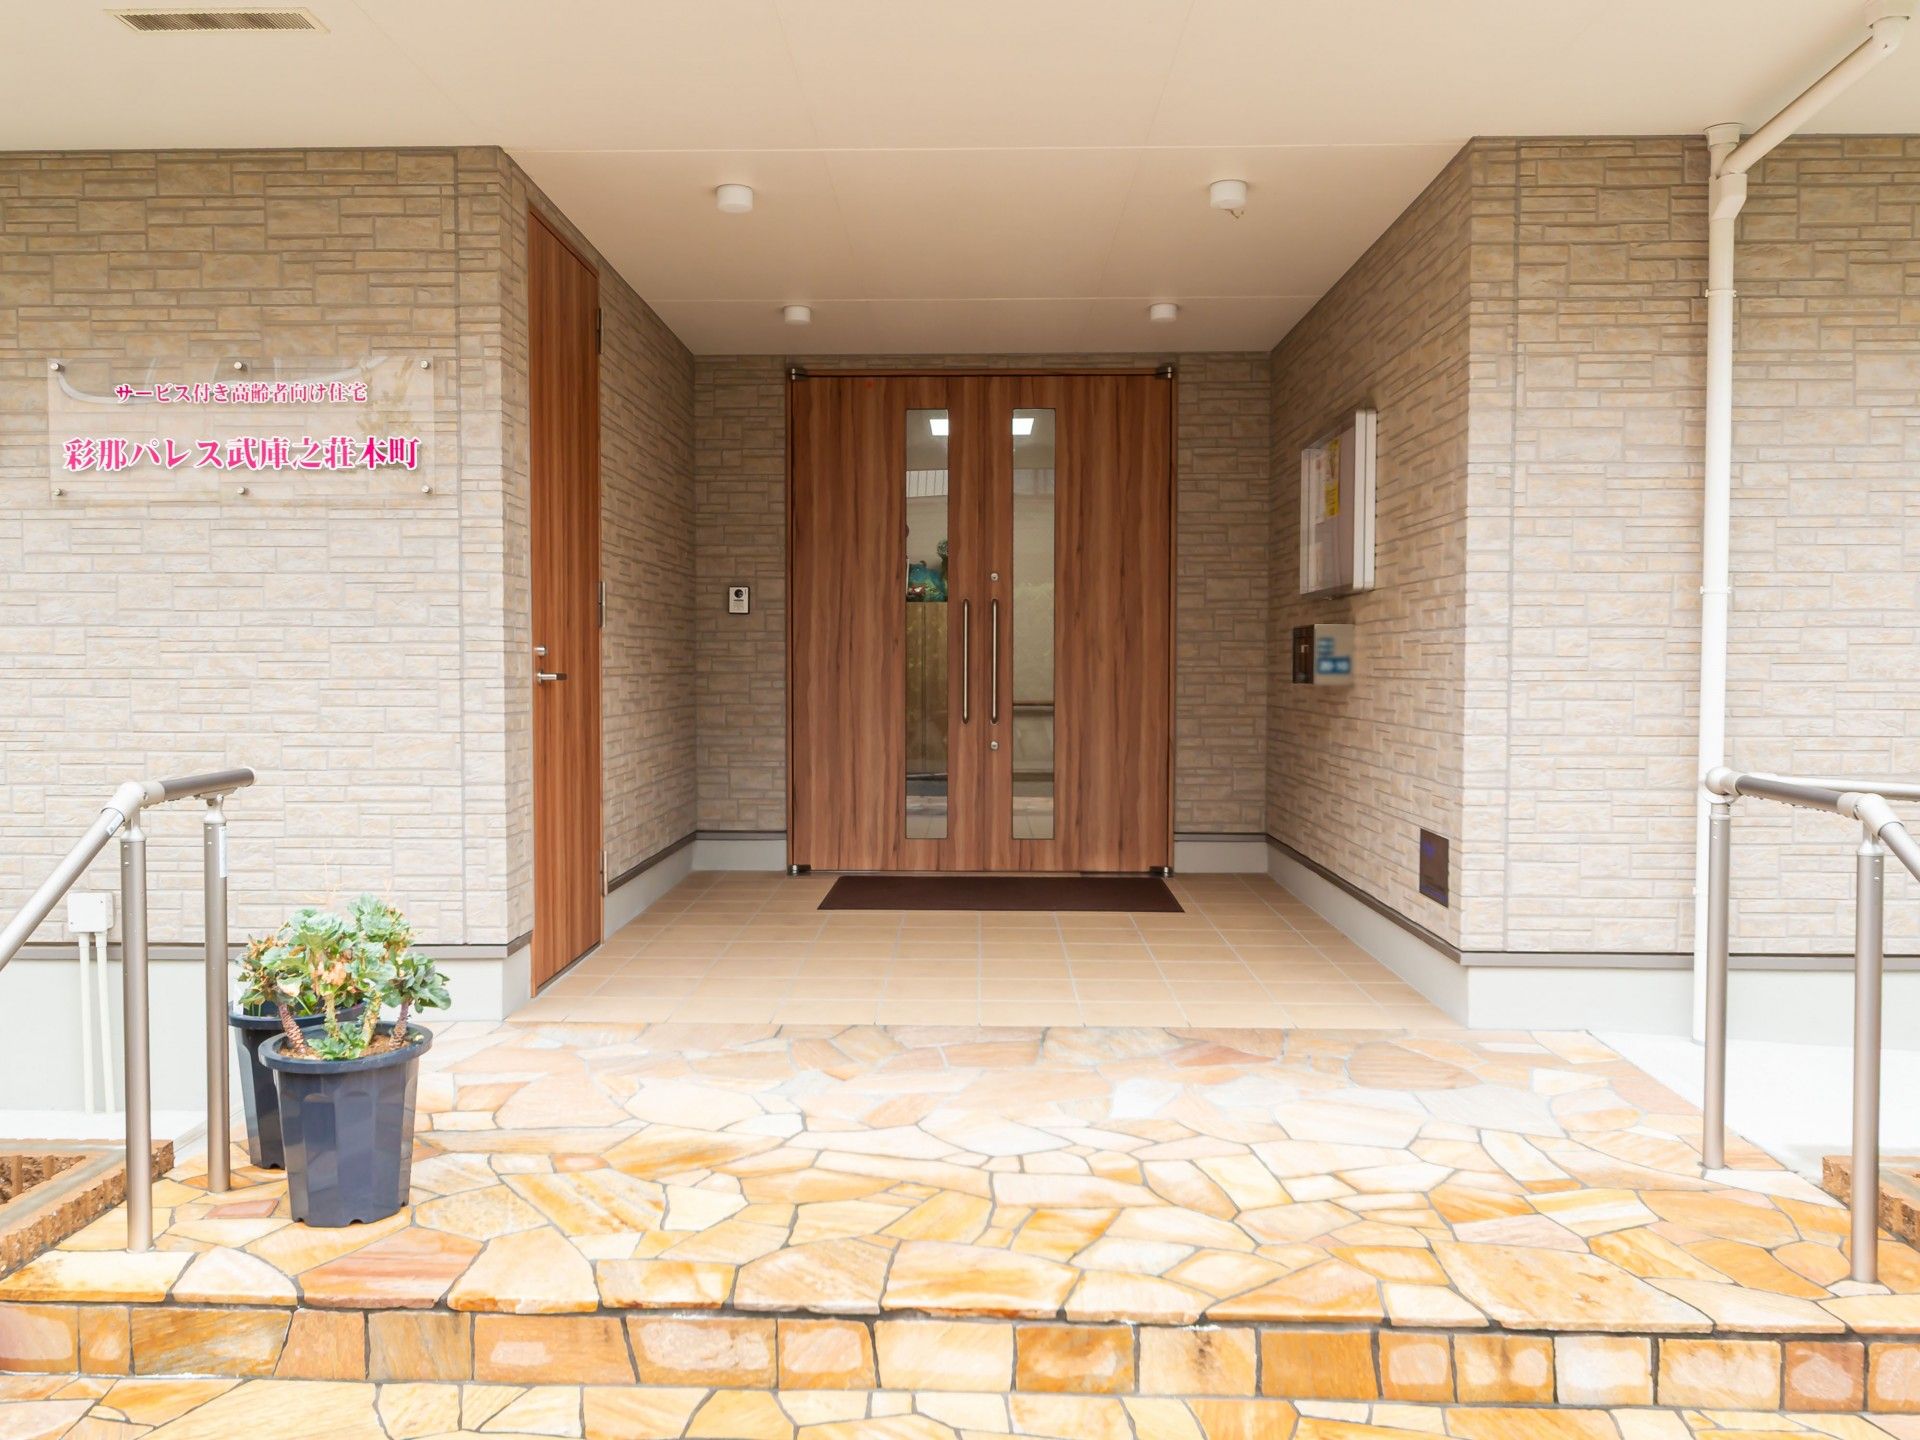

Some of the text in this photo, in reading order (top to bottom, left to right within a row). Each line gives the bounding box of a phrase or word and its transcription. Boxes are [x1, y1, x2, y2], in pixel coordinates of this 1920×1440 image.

[114, 383, 368, 403] サービス付き高齢者向け住宅
[63, 436, 420, 471] 彩那パレス武庫之荘本町
